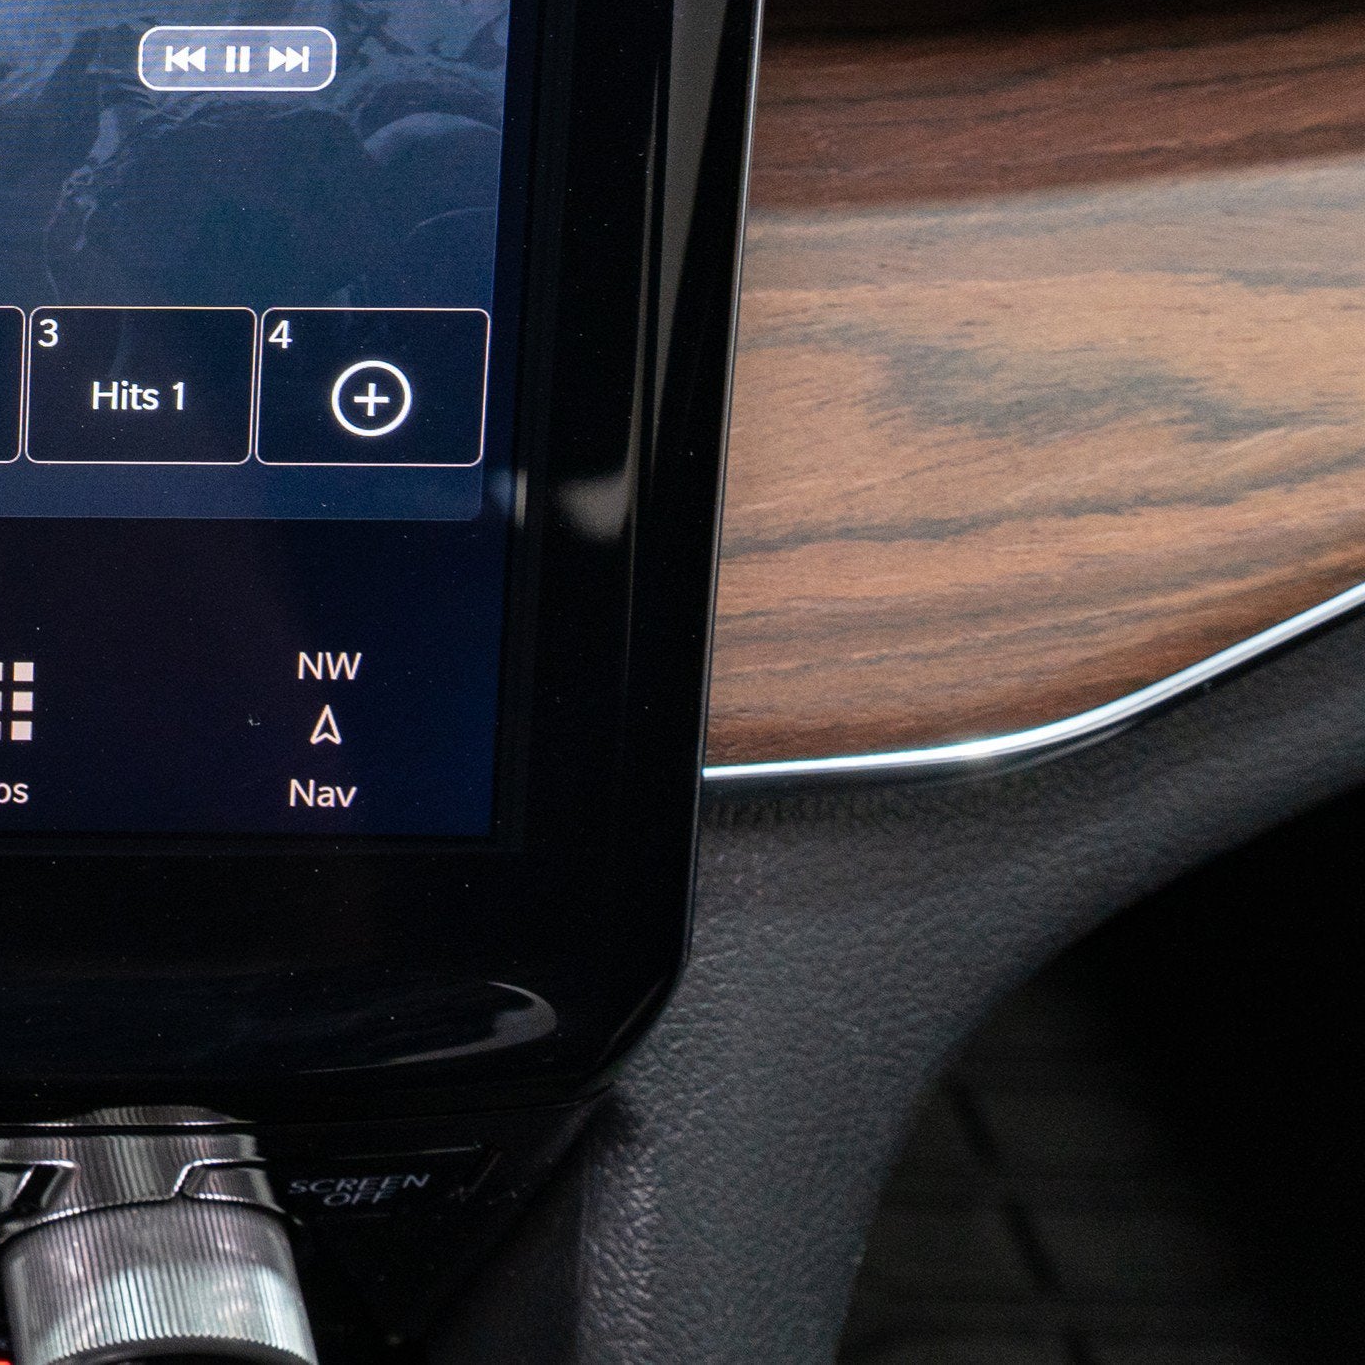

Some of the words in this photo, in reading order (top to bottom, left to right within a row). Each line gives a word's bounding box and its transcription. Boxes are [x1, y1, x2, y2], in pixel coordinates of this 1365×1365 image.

[37, 318, 59, 348] 3
[268, 320, 293, 349] 4
[91, 381, 160, 411] Hits
[172, 382, 185, 410] 1
[297, 651, 362, 681] NW
[289, 779, 357, 808] Nav
[288, 1172, 431, 1195] SCREEN
[323, 1190, 393, 1208] OFF
